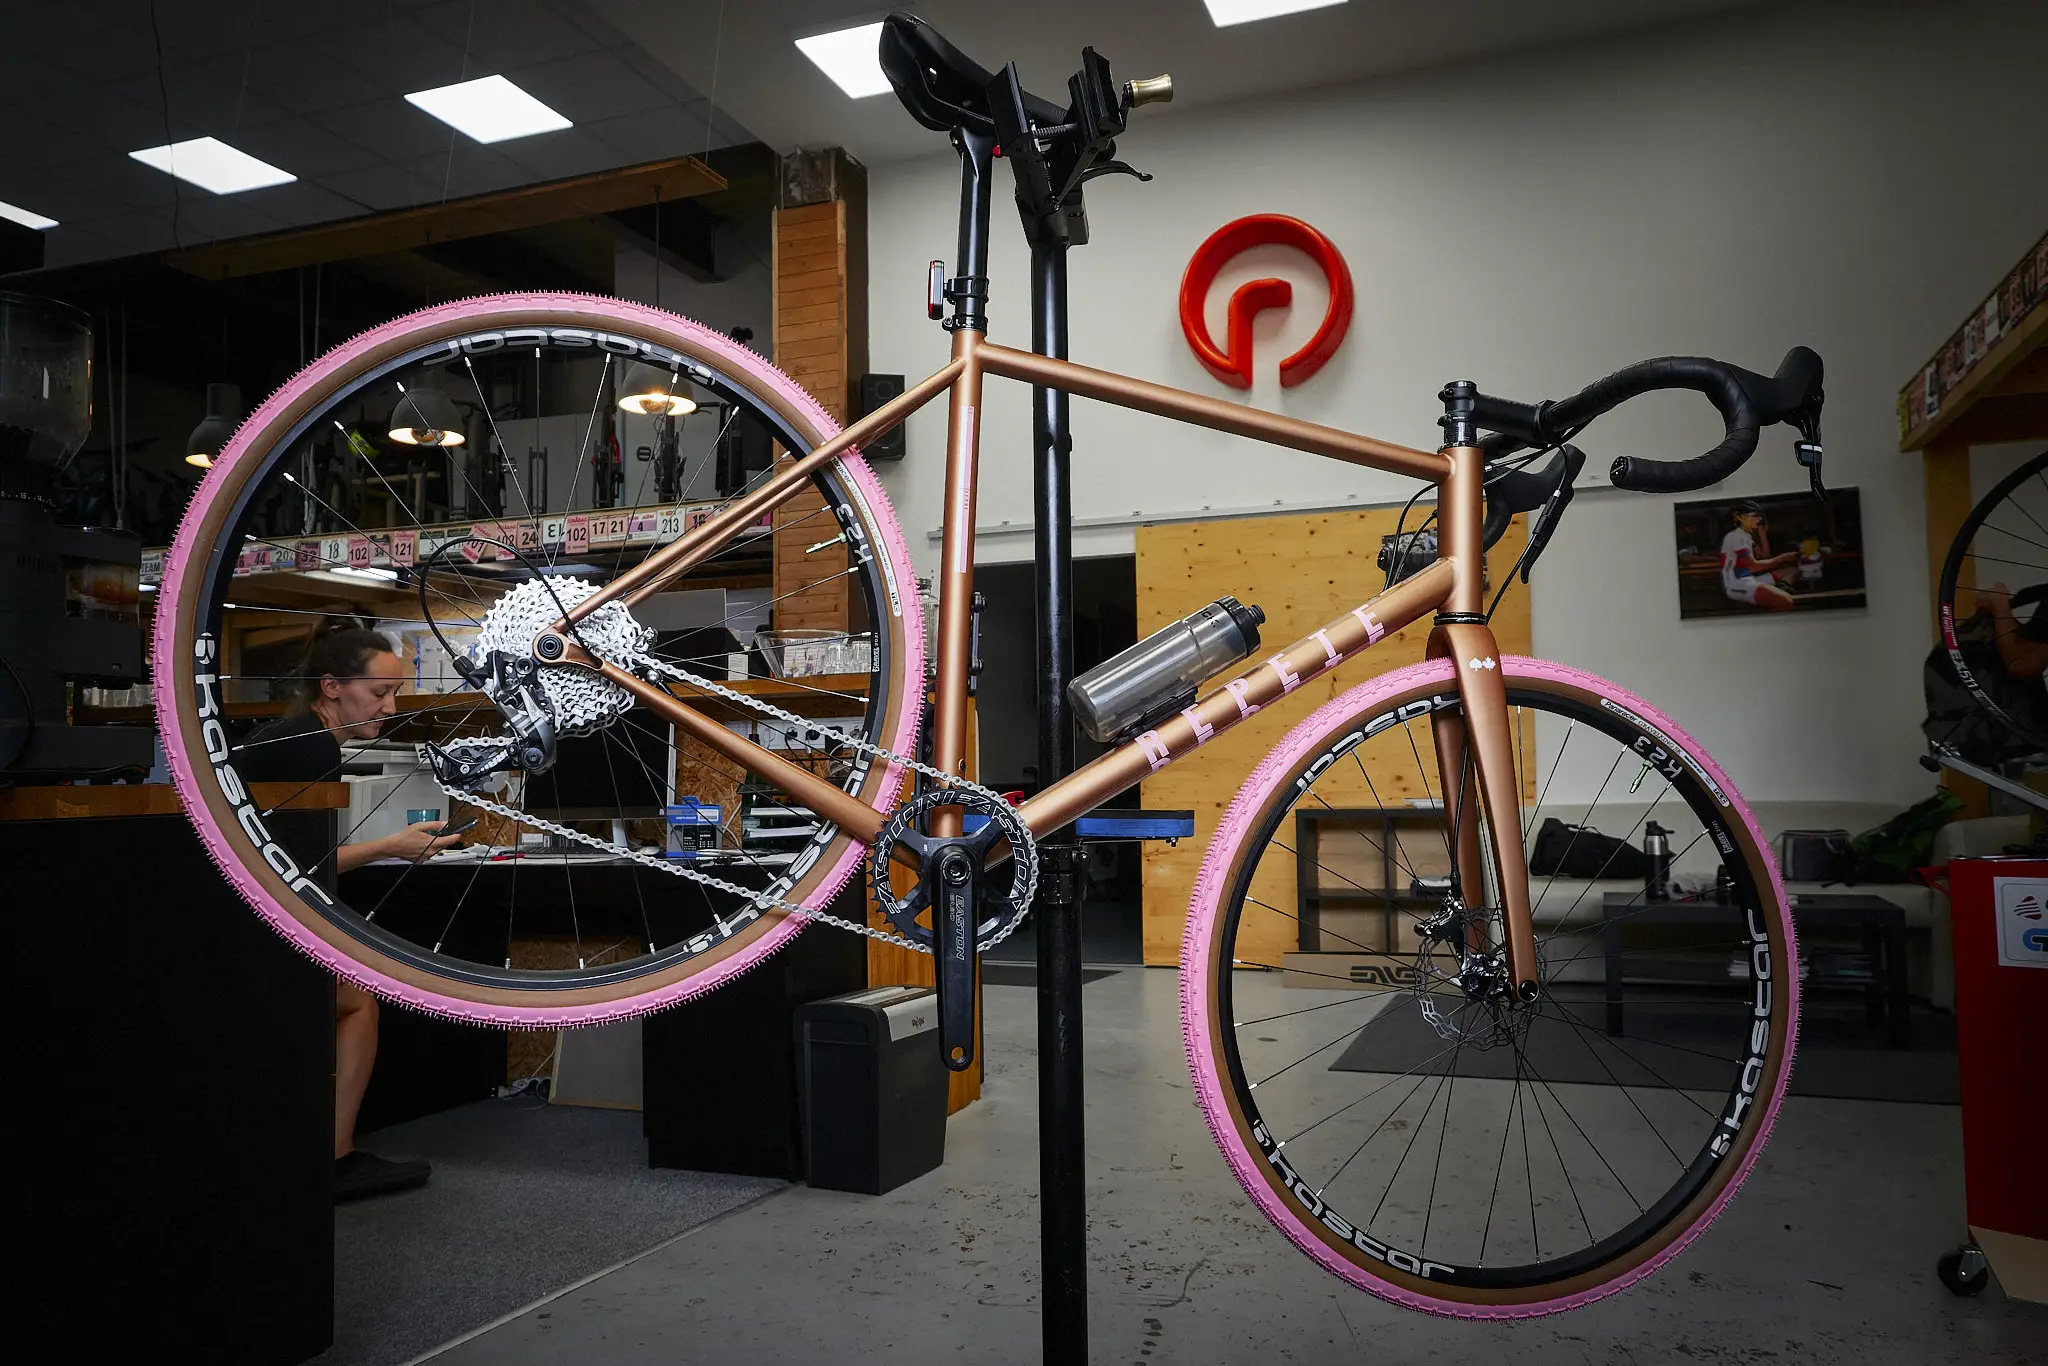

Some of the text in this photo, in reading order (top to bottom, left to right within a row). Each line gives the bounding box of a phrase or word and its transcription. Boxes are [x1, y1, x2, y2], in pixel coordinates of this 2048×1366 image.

[592, 522, 606, 535] 17
[610, 519, 624, 533] 21
[637, 521, 644, 532] 4
[662, 517, 680, 534] 213
[836, 503, 874, 565] K23
[522, 532, 537, 546] 24
[567, 527, 587, 542] 102
[328, 542, 340, 560] 18
[349, 547, 368, 562] 102
[395, 542, 412, 556] 121
[140, 562, 160, 573] TEAM
[1134, 603, 1385, 772] REPETE
[1605, 701, 1638, 723] Panaracer
[1638, 721, 1675, 751] GRAVELKING
[1633, 735, 1684, 779] K23
[195, 673, 333, 906] kastar
[954, 894, 967, 962] EASTON
[1723, 909, 1772, 1131] kastar
[1267, 1150, 1456, 1279] kastar
